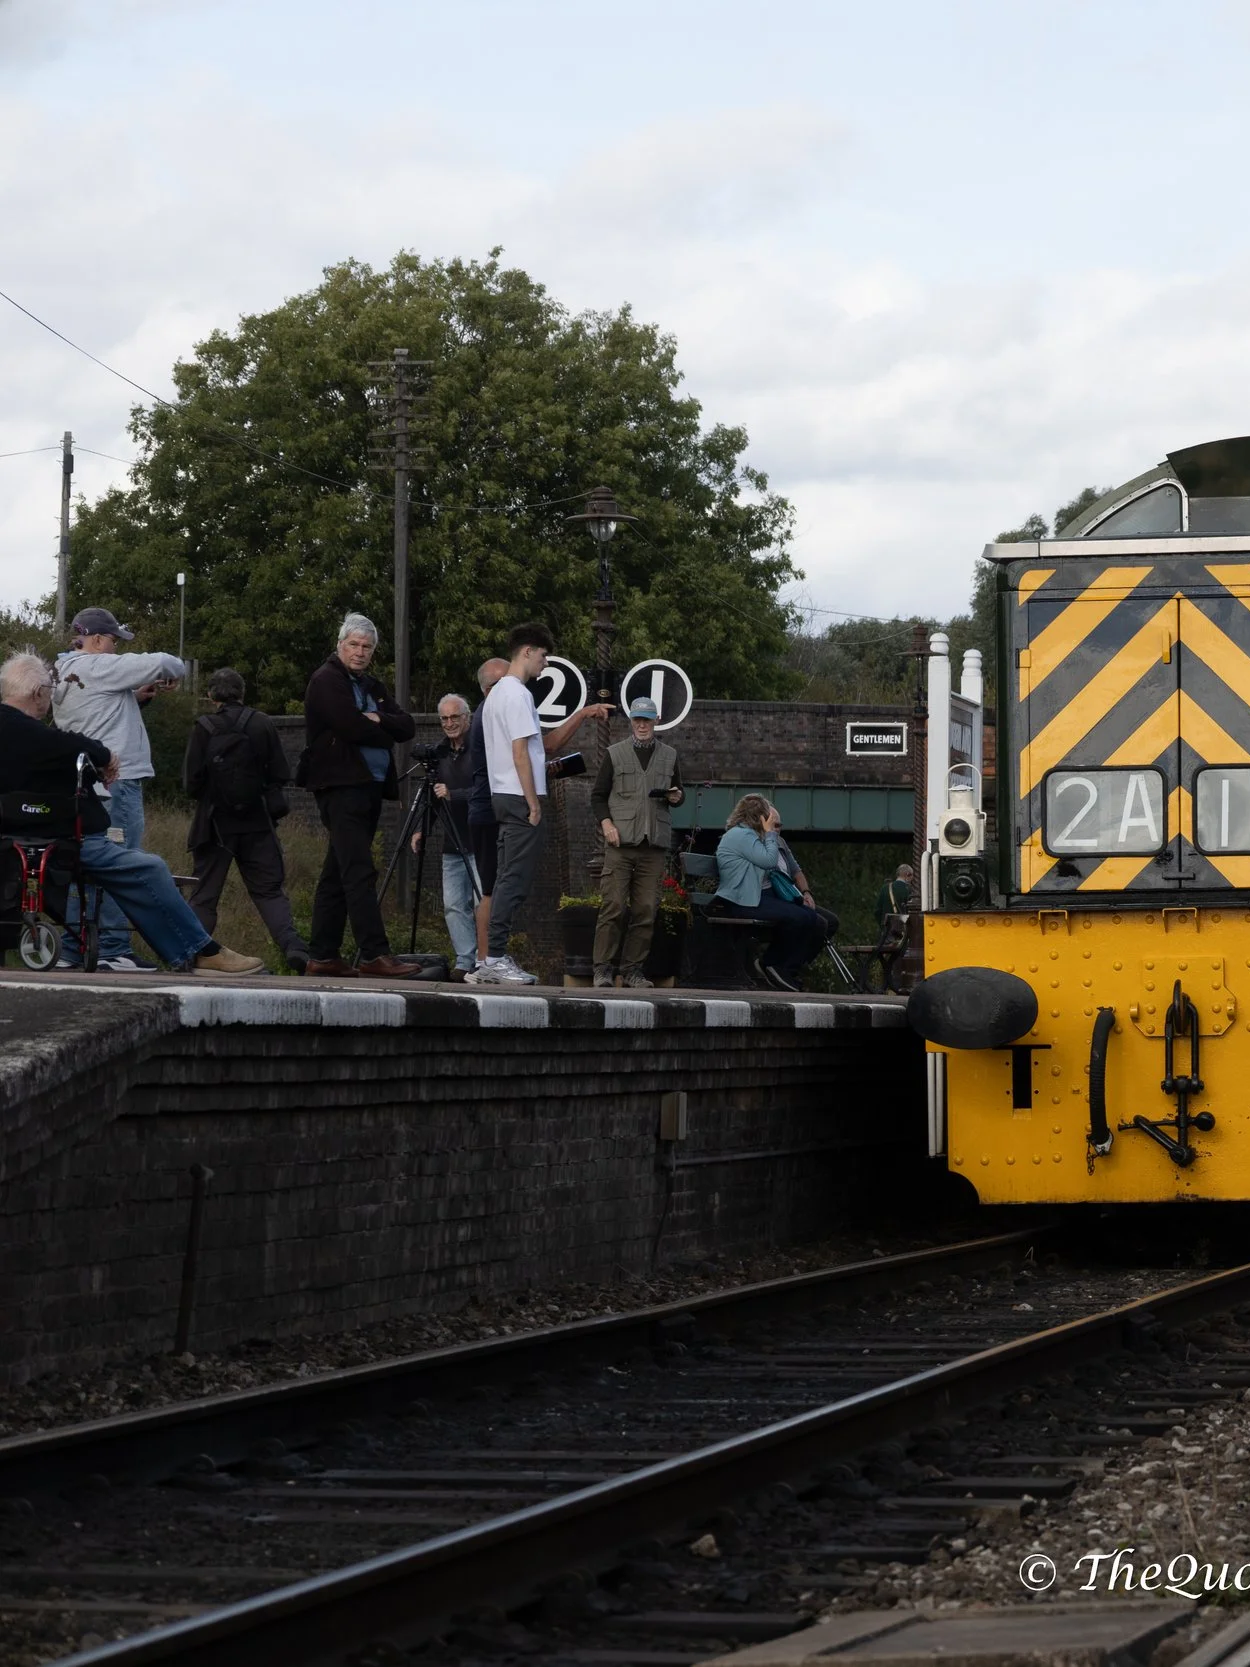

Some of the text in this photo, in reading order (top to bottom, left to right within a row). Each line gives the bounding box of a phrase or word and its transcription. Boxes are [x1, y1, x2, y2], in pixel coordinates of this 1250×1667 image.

[536, 666, 567, 716] 2
[650, 670, 664, 720] 1
[853, 734, 901, 744] GENTLEMEN
[21, 803, 51, 814] CareCo
[1052, 774, 1159, 847] 2A
